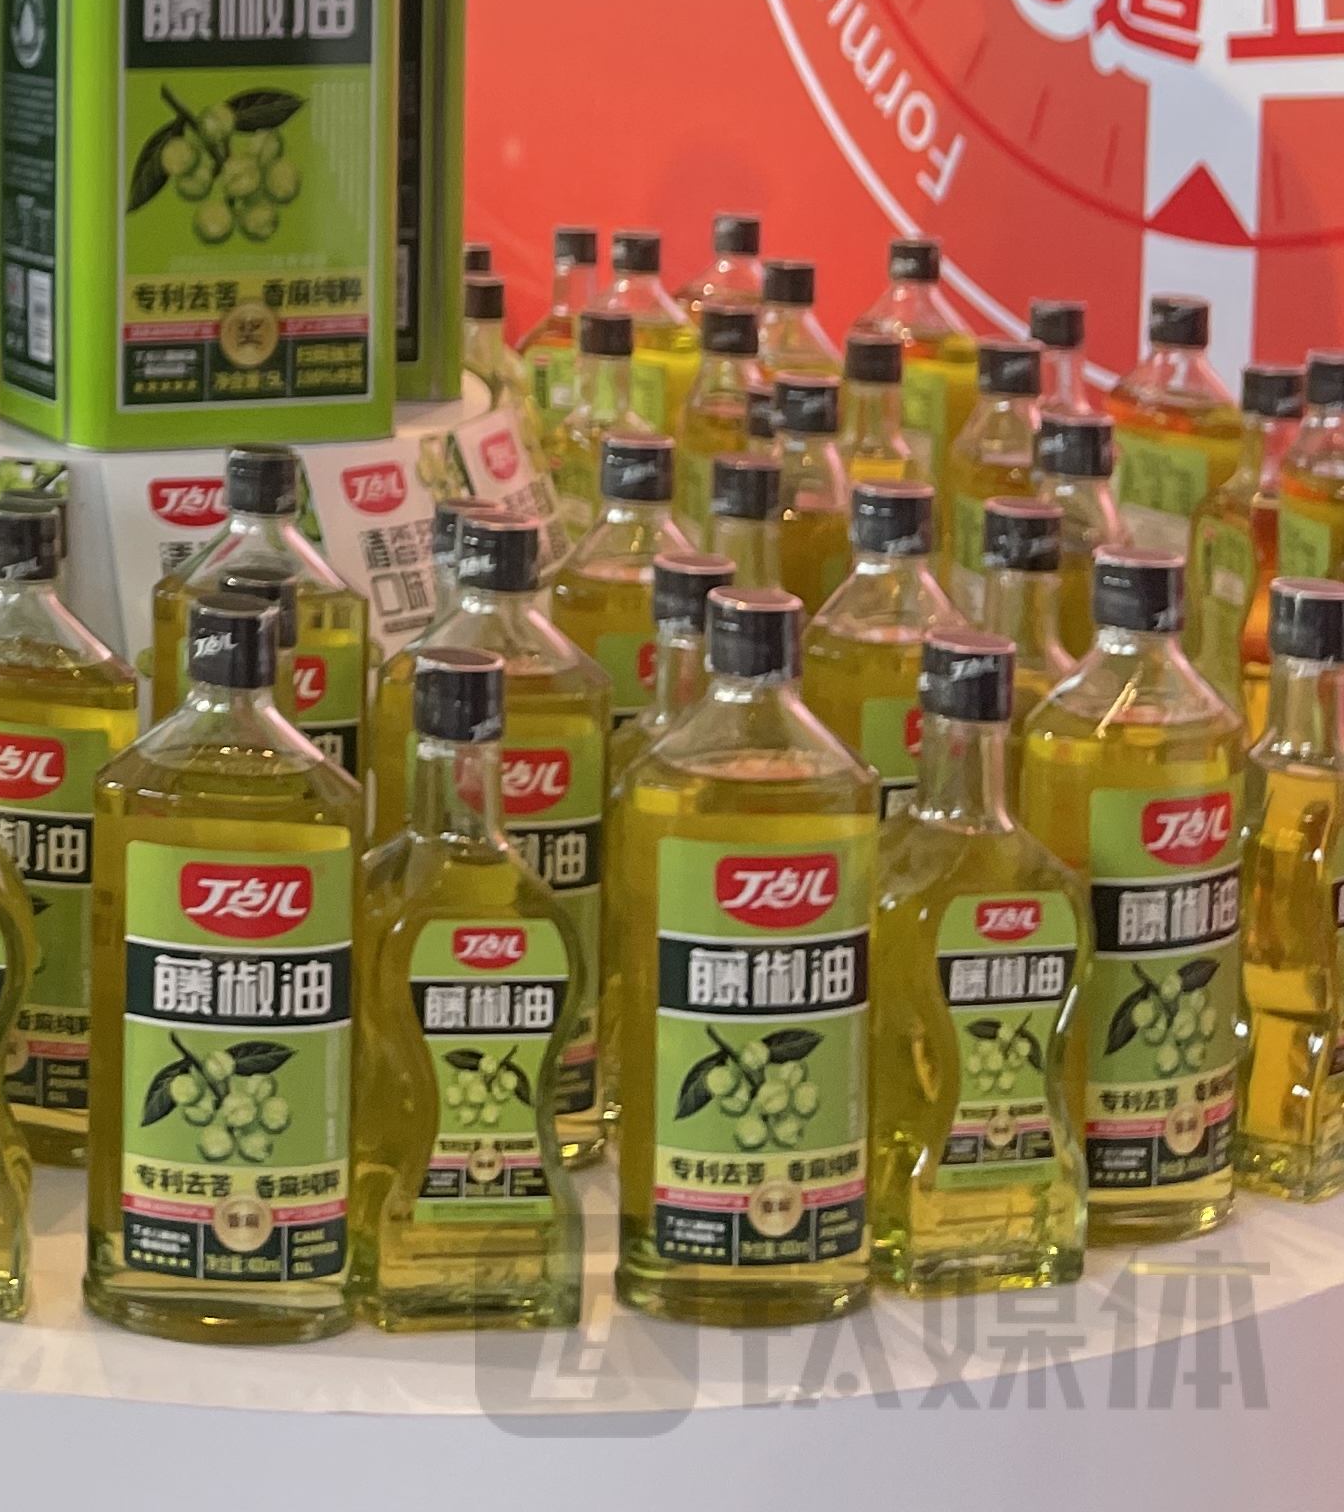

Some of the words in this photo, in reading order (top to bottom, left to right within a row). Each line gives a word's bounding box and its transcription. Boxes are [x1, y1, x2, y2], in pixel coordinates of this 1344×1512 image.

[185, 877, 308, 919] 丁点儿
[721, 867, 838, 910] 丁点儿
[152, 954, 333, 1019] 藤椒油
[688, 946, 855, 1008] 藤椒油
[424, 984, 555, 1029] 藤椒油
